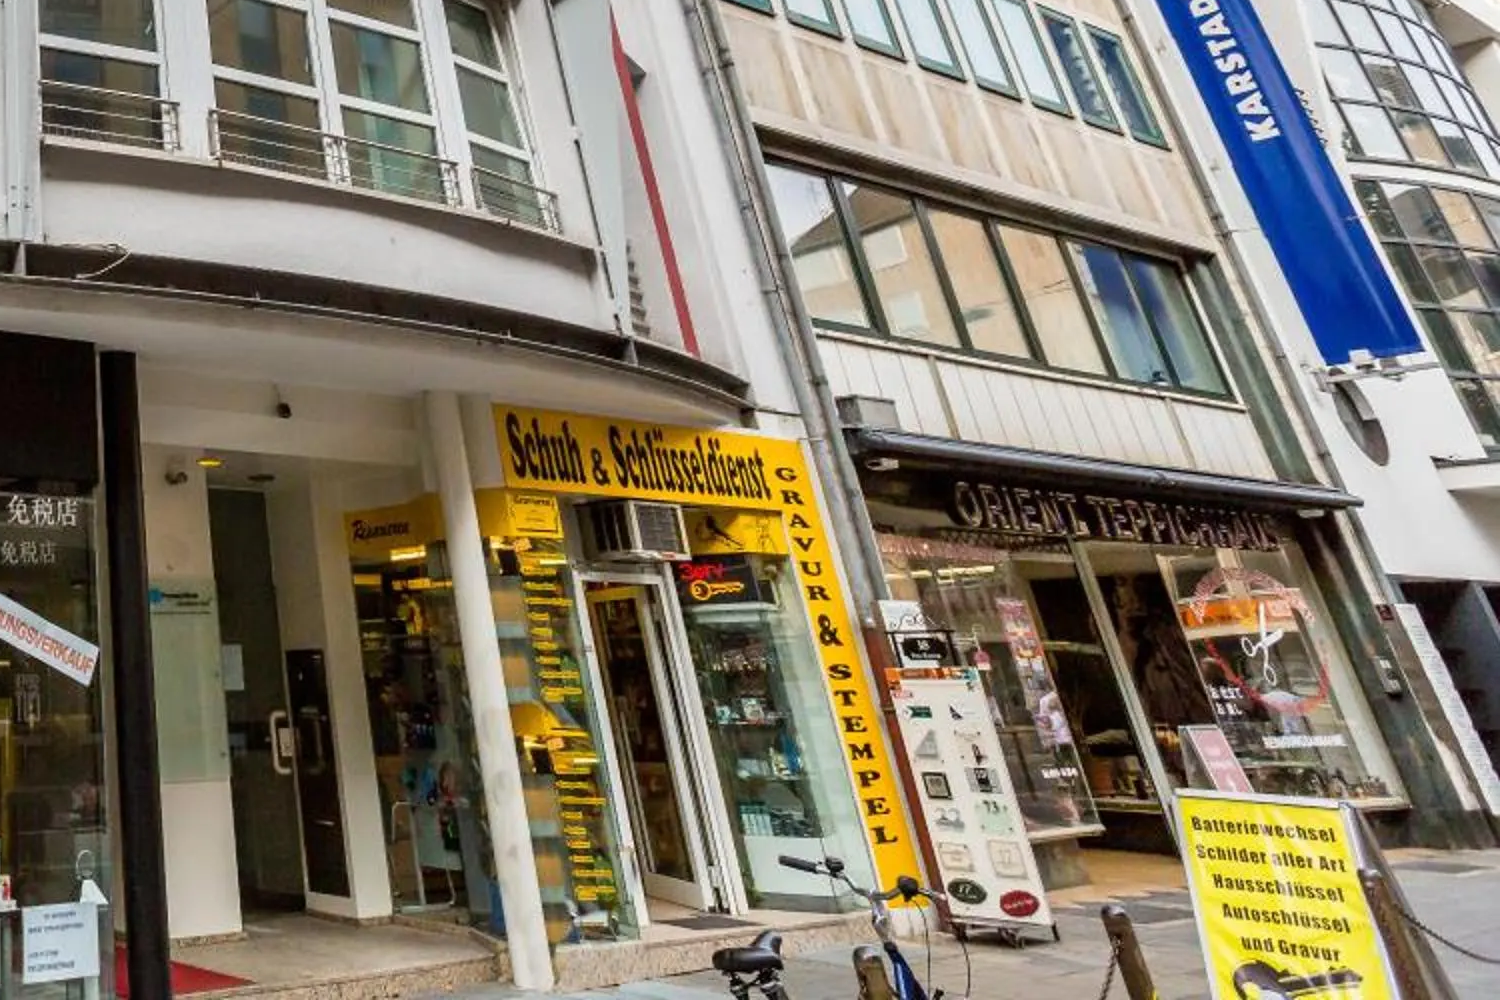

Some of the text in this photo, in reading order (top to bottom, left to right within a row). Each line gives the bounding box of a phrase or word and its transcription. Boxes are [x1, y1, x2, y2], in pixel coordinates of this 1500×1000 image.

[505, 411, 772, 501] Schuh & Schlüsseldienst
[6, 494, 78, 527] 免税店
[955, 480, 1091, 537] ORIENT
[774, 467, 898, 845] GRAVUR & STEMPEL
[1191, 815, 1338, 844] Batteriewechsel
[1195, 843, 1347, 873] Schilder aller Art
[1211, 873, 1345, 903] Hausschlüssel
[1221, 903, 1352, 934] Autoschlüssel
[1241, 936, 1341, 962] und Gravur
